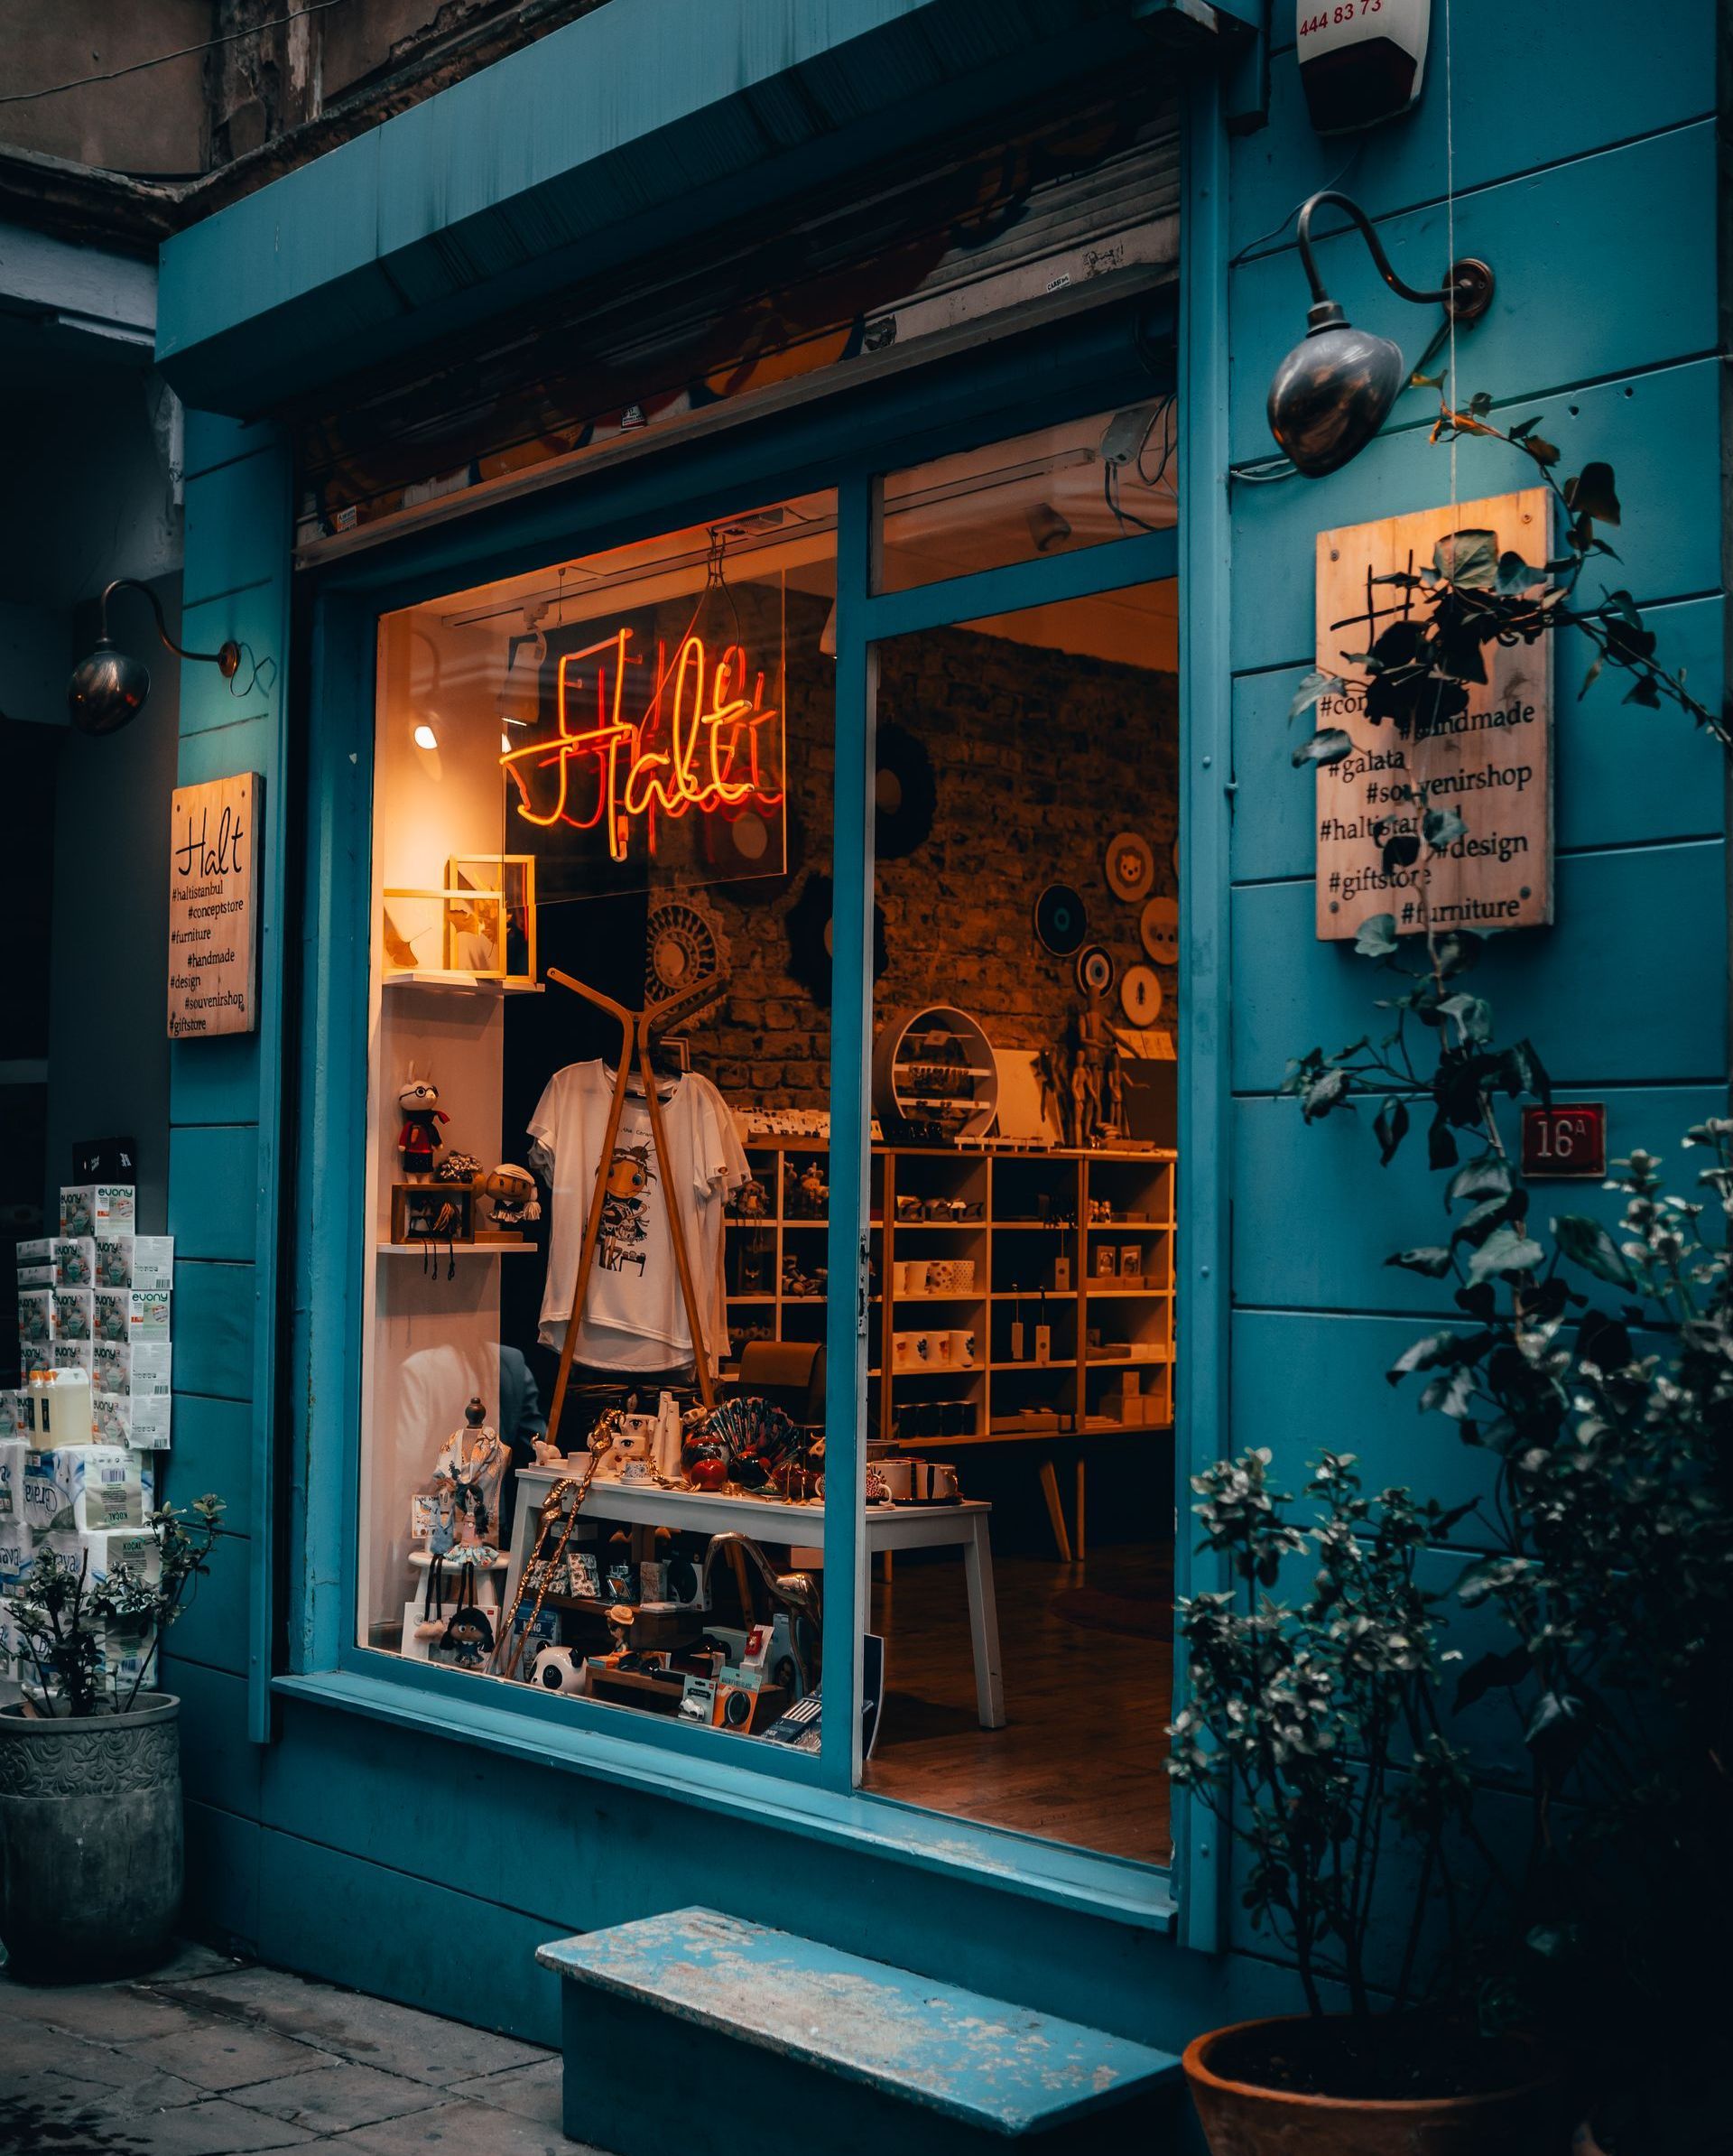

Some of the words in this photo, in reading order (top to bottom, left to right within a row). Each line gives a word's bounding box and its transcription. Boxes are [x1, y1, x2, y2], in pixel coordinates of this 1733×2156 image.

[1300, 13, 1329, 36] 444
[1333, 4, 1354, 24] 83
[1360, 0, 1382, 14] 73
[499, 628, 755, 862] Halt
[1329, 750, 1404, 783] #galata
[1367, 764, 1533, 804] #sovenirshop
[175, 806, 244, 878] Halt
[171, 880, 224, 902] #haltistanbul
[188, 898, 244, 920] #conceptstore
[171, 928, 211, 943] #furniture
[187, 951, 235, 968] #handmade
[170, 975, 201, 992] #design
[185, 991, 245, 1010] #souvenirshop
[169, 1018, 207, 1037] #giftstore
[98, 1188, 133, 1197] evony
[132, 1293, 168, 1303] evony
